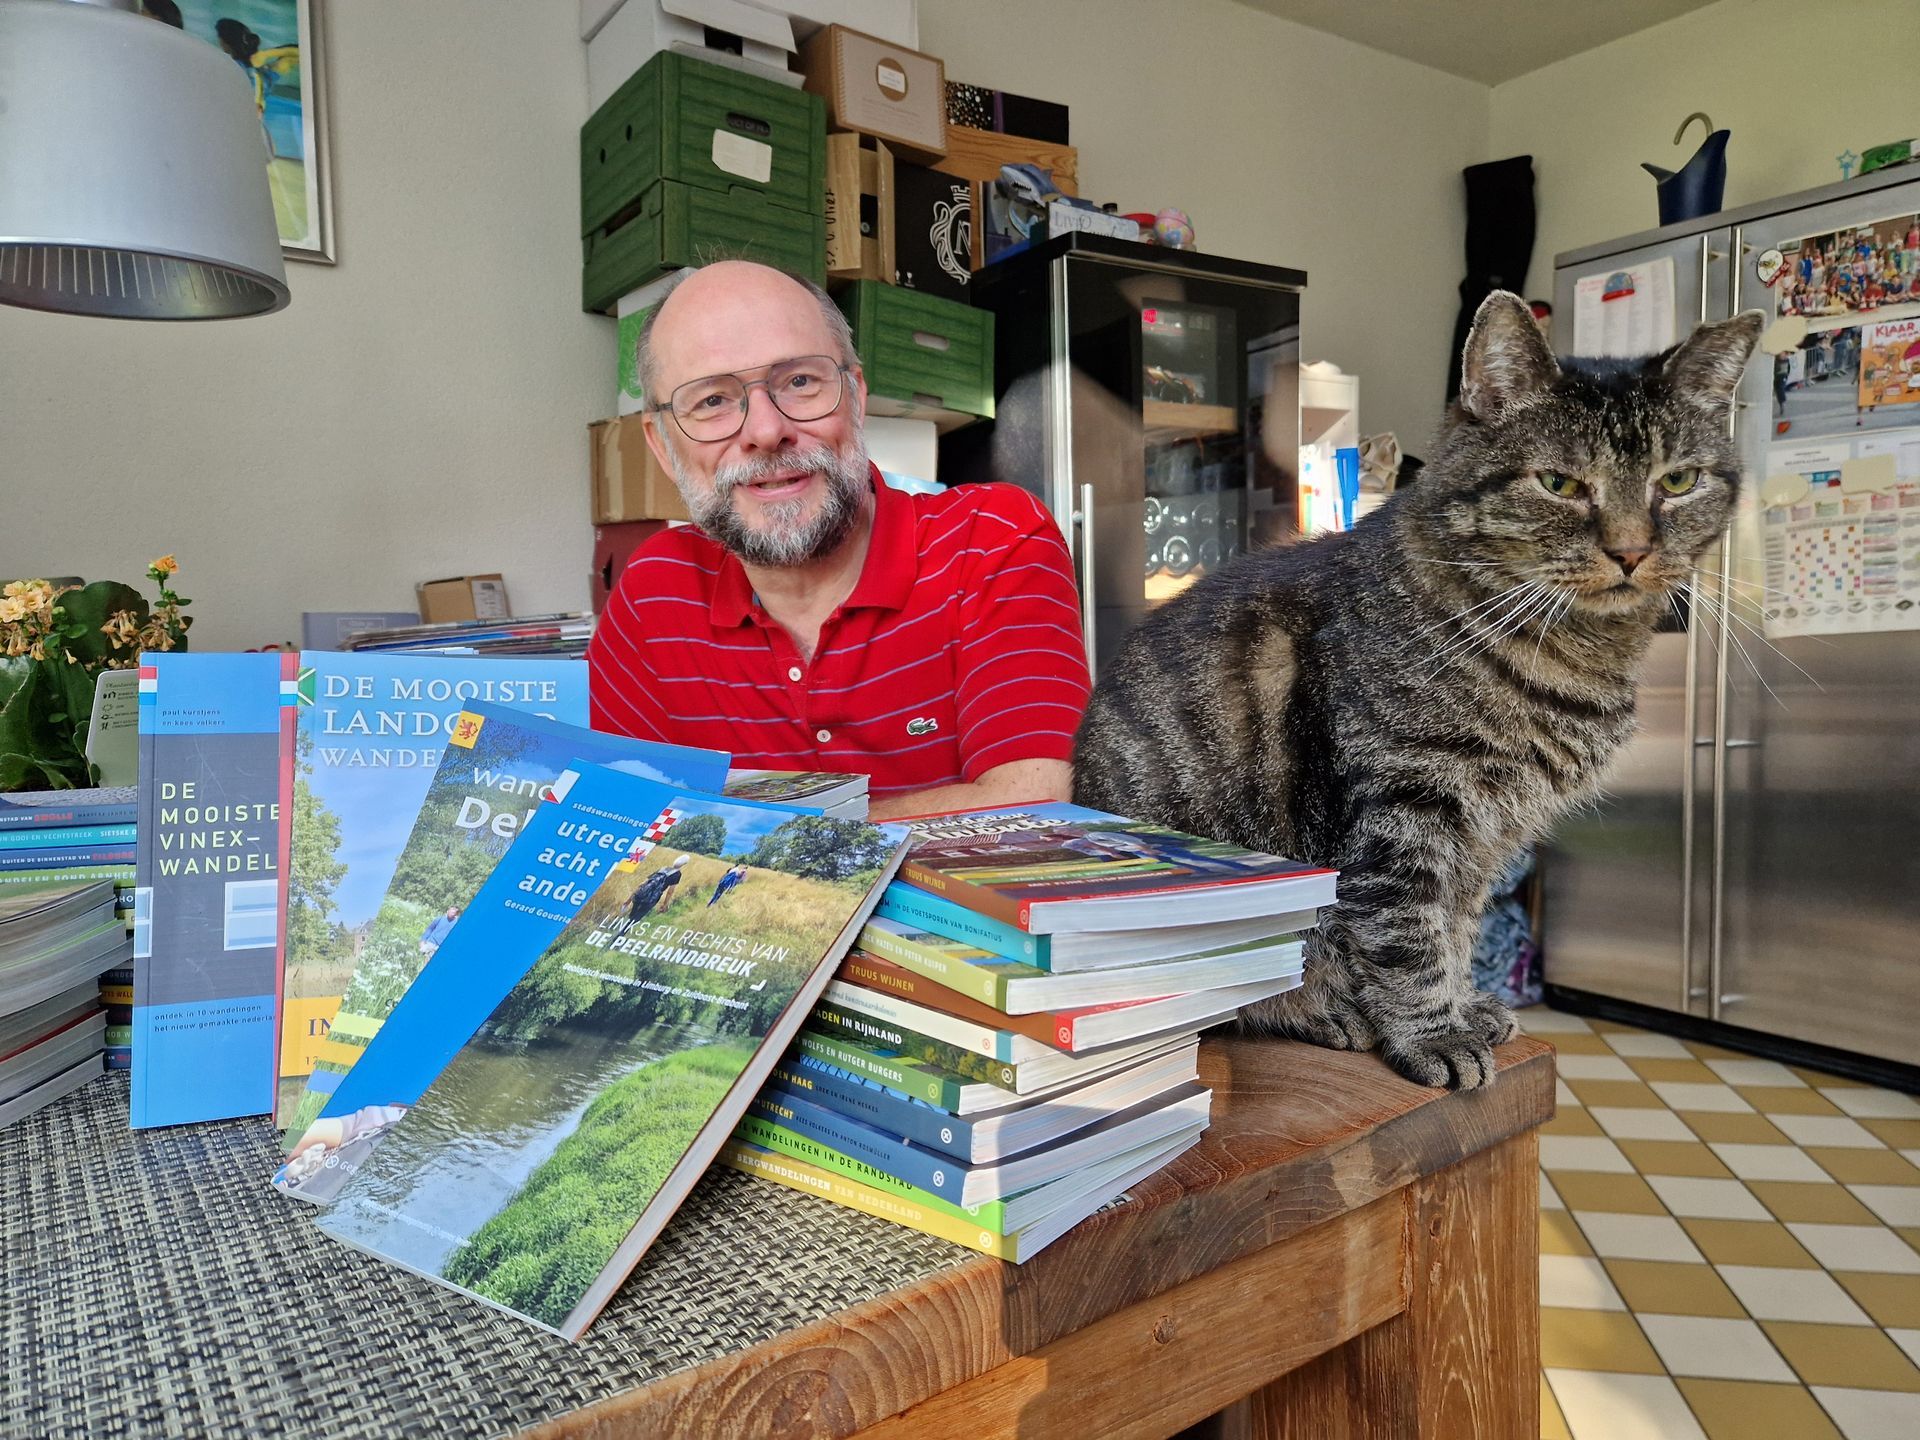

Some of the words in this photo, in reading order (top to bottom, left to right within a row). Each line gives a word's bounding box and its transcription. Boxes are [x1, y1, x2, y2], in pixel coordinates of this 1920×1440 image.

[1875, 322, 1915, 337] KLAAR
[324, 675, 374, 698] DE
[391, 678, 557, 702] MOOISTE
[162, 709, 180, 717] paul
[161, 782, 196, 800] DE
[161, 804, 279, 825] MOOISTE
[572, 801, 650, 829] stadswandelingen
[43, 831, 93, 840] VECHTSTREEK
[911, 817, 1072, 841] Twente
[537, 847, 601, 877] acht
[518, 873, 587, 907] ande
[905, 867, 923, 882] TRUUS
[923, 873, 946, 891] WIJNEN
[504, 899, 535, 915] Gerard
[902, 904, 911, 913] DE
[911, 905, 949, 925] VOETSPOREN
[950, 919, 963, 930] VAN
[964, 925, 1002, 943] BONIFATIUS
[599, 914, 651, 937] LINKS
[651, 925, 677, 942] EN
[678, 929, 746, 954] RECHTS
[749, 941, 789, 963] VAN
[584, 930, 612, 949] DE
[609, 935, 758, 977] PEELRANDBREUK
[641, 979, 671, 995] Limburg
[671, 986, 683, 995] en
[850, 964, 878, 981] TRUUS
[880, 973, 915, 993] WIJNEN
[155, 1013, 183, 1021] ontdek
[197, 1009, 207, 1017] 10
[209, 1005, 261, 1016] wandelingen
[171, 1023, 196, 1031] nieuw
[198, 1019, 240, 1029] gemaakte
[842, 1016, 852, 1029] IN
[854, 1021, 902, 1045] RIJNLAND
[801, 1039, 824, 1053] WOLFS
[826, 1046, 836, 1057] EN
[838, 1051, 866, 1069] RUTGER
[868, 1062, 903, 1083] BURGERS
[791, 1075, 813, 1090] HAAG
[761, 1099, 794, 1120] UTRECHT
[751, 1122, 819, 1157] WANDELINGEN
[824, 1151, 835, 1163] IN
[839, 1156, 852, 1168] DE
[857, 1163, 913, 1190] RANDSTAD
[736, 1153, 831, 1191] BERGWANDELINGEN
[834, 1184, 854, 1199] VAN
[858, 1191, 923, 1221] NEDERLAND
